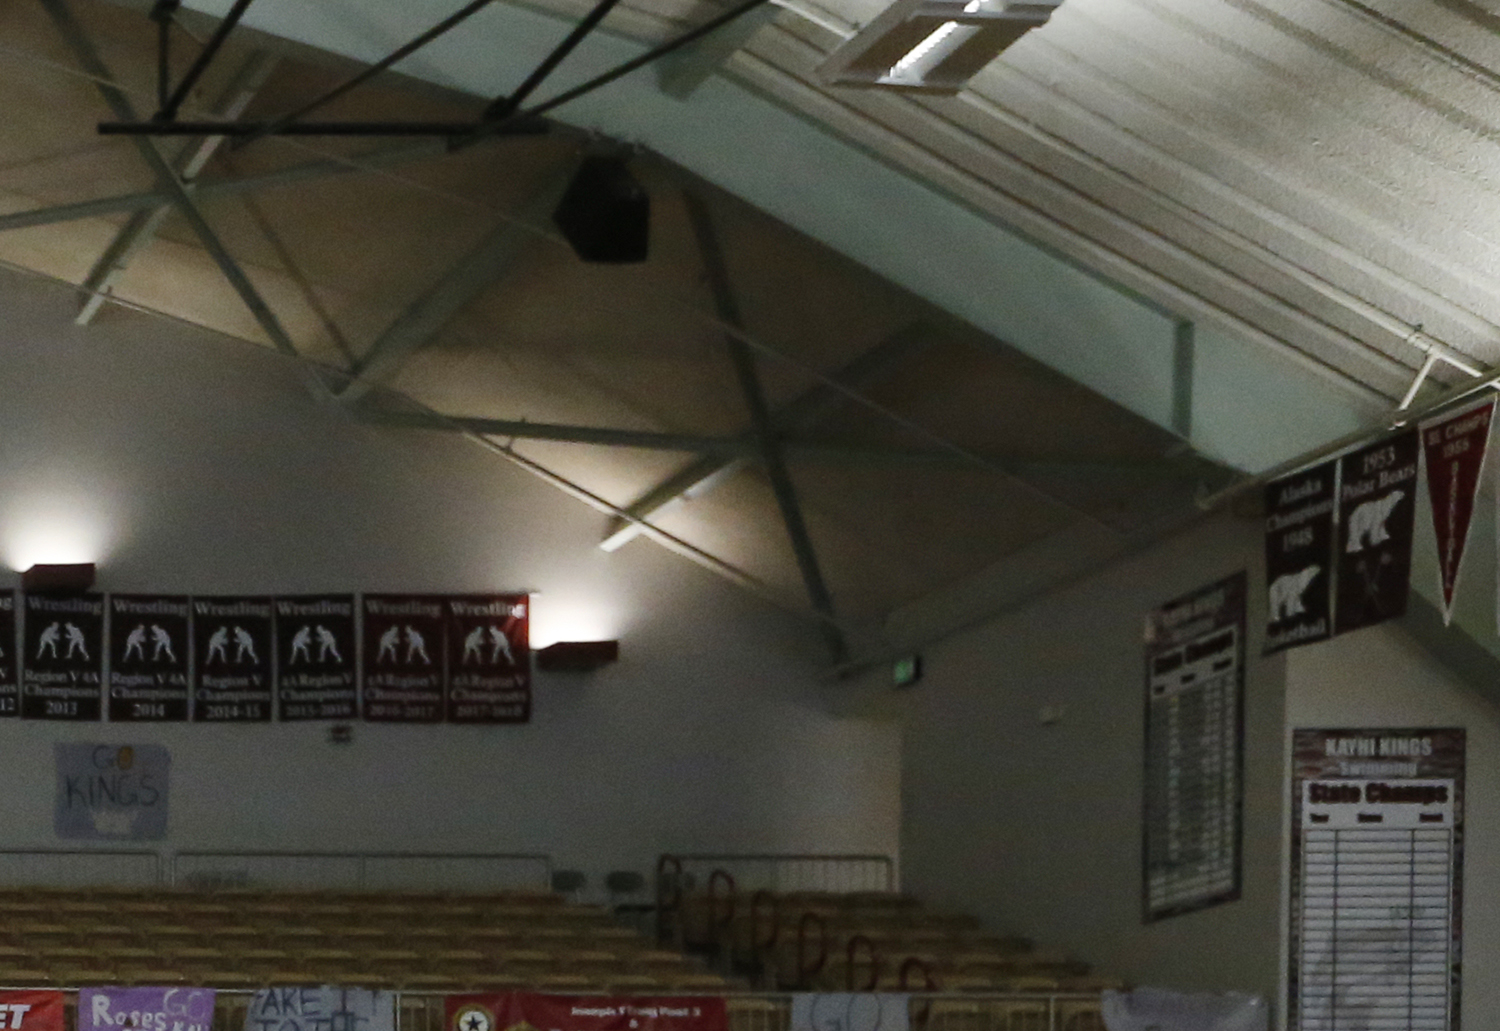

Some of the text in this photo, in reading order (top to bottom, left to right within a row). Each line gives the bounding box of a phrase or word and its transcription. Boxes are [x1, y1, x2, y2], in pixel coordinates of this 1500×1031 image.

[1326, 738, 1432, 756] KAYHI KINGS
[66, 774, 159, 809] KINGS
[253, 987, 320, 1017] AKE
